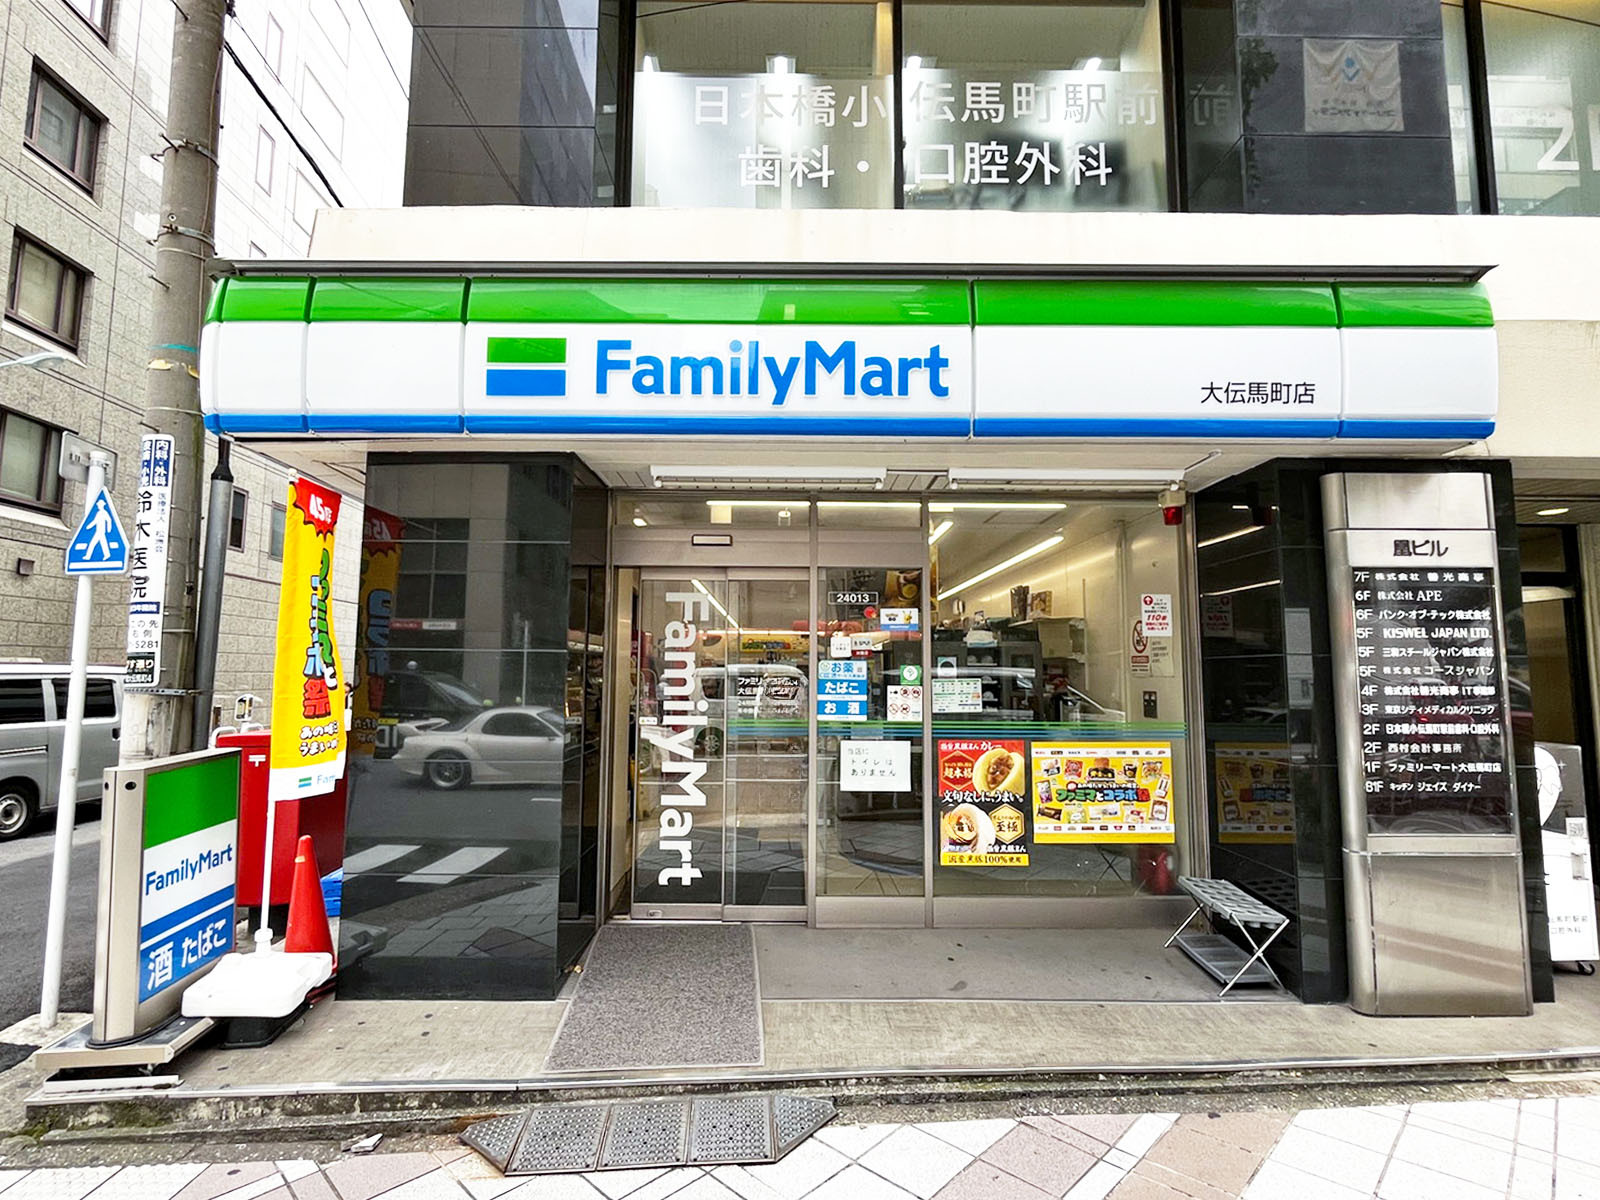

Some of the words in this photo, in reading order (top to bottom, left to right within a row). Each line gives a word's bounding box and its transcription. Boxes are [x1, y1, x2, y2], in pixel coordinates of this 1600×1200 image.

[694, 80, 1158, 128] 日本橋小伝馬町駅前
[738, 141, 1113, 188] 歯科・口腔外科
[595, 338, 950, 405] FamilyMart
[1201, 381, 1316, 404] 大伝馬町店
[1354, 571, 1370, 582] 7F
[1375, 572, 1420, 581] 株式会社
[836, 593, 870, 603] 24013
[1355, 590, 1371, 601] 6F
[1377, 590, 1413, 601] 株式会社
[1416, 590, 1443, 601] APE
[1356, 609, 1373, 620] 6F
[1357, 628, 1373, 639] 5F
[1383, 628, 1429, 639] KISWEL
[1431, 628, 1468, 638] JAPAN
[1470, 628, 1493, 639] LTD.
[1358, 647, 1375, 658] 5F
[1359, 666, 1377, 677] 5F
[1383, 666, 1421, 675] 株式会社
[825, 682, 860, 694] たばこ
[1361, 685, 1378, 696] 4F
[824, 701, 860, 714] お酒
[1361, 703, 1379, 715] 3F
[1363, 723, 1380, 735] 2F
[641, 592, 710, 886] FamilyMart
[1364, 742, 1382, 753] 2F
[850, 768, 897, 777] ありません
[1365, 761, 1382, 773] 1F
[1388, 762, 1502, 773] ファミリーマート大伝馬町店
[1389, 782, 1414, 791] キッチン
[1417, 781, 1448, 792] ジェイズ
[1452, 781, 1482, 792] ダイナー
[942, 790, 1024, 803] 文句なしに、うまい。
[145, 844, 233, 896] FamilyMart
[147, 941, 174, 991] 酒
[181, 918, 227, 969] たばこ
